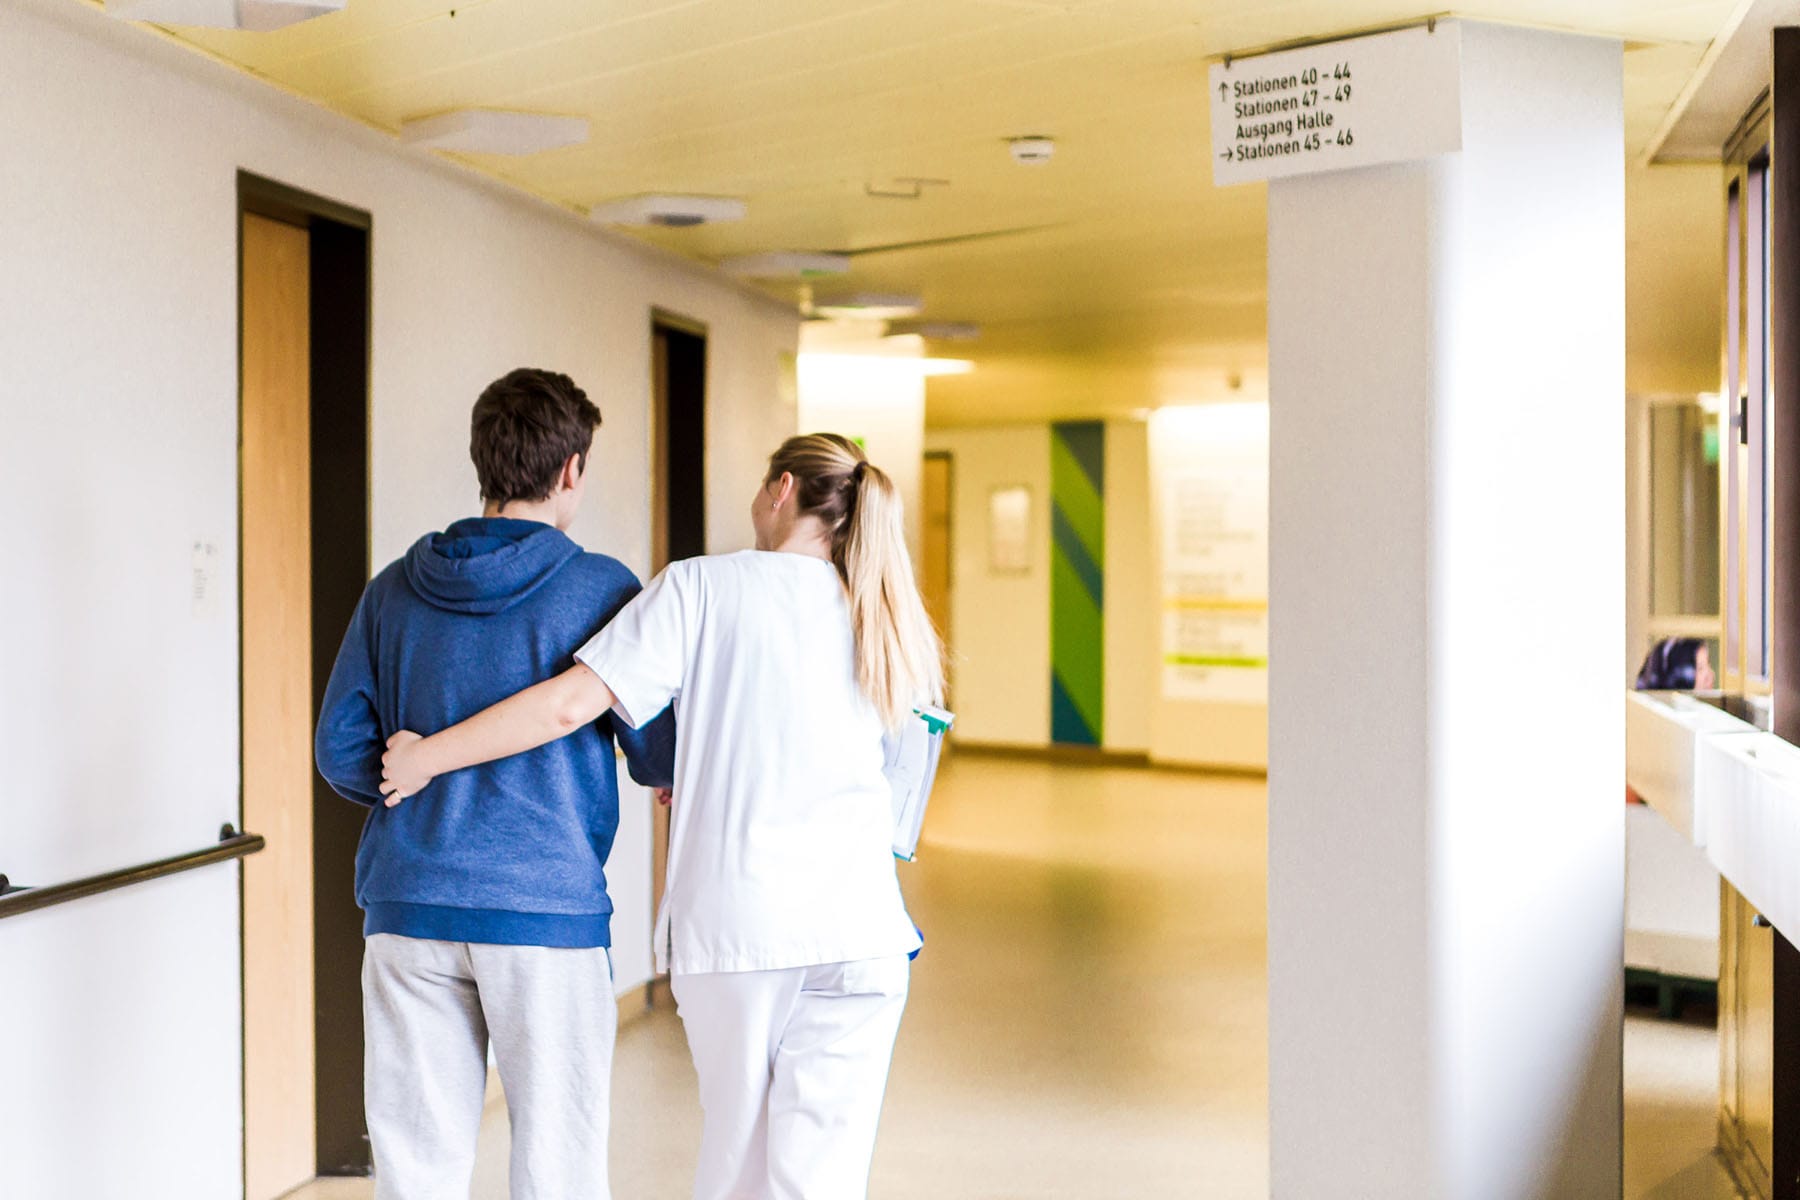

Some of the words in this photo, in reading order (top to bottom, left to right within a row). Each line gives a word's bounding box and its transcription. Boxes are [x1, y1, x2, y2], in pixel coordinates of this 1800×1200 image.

[1234, 75, 1297, 98] Stationen
[1301, 68, 1317, 85] 40
[1334, 62, 1350, 79] 44
[1235, 97, 1298, 118] Stationen
[1302, 90, 1317, 107] 47
[1335, 85, 1351, 101] 49
[1236, 119, 1292, 141] Ausgang
[1298, 112, 1333, 130] Halle
[1237, 140, 1299, 161] Stationen
[1304, 133, 1320, 150] 45
[1337, 128, 1353, 146] 46
